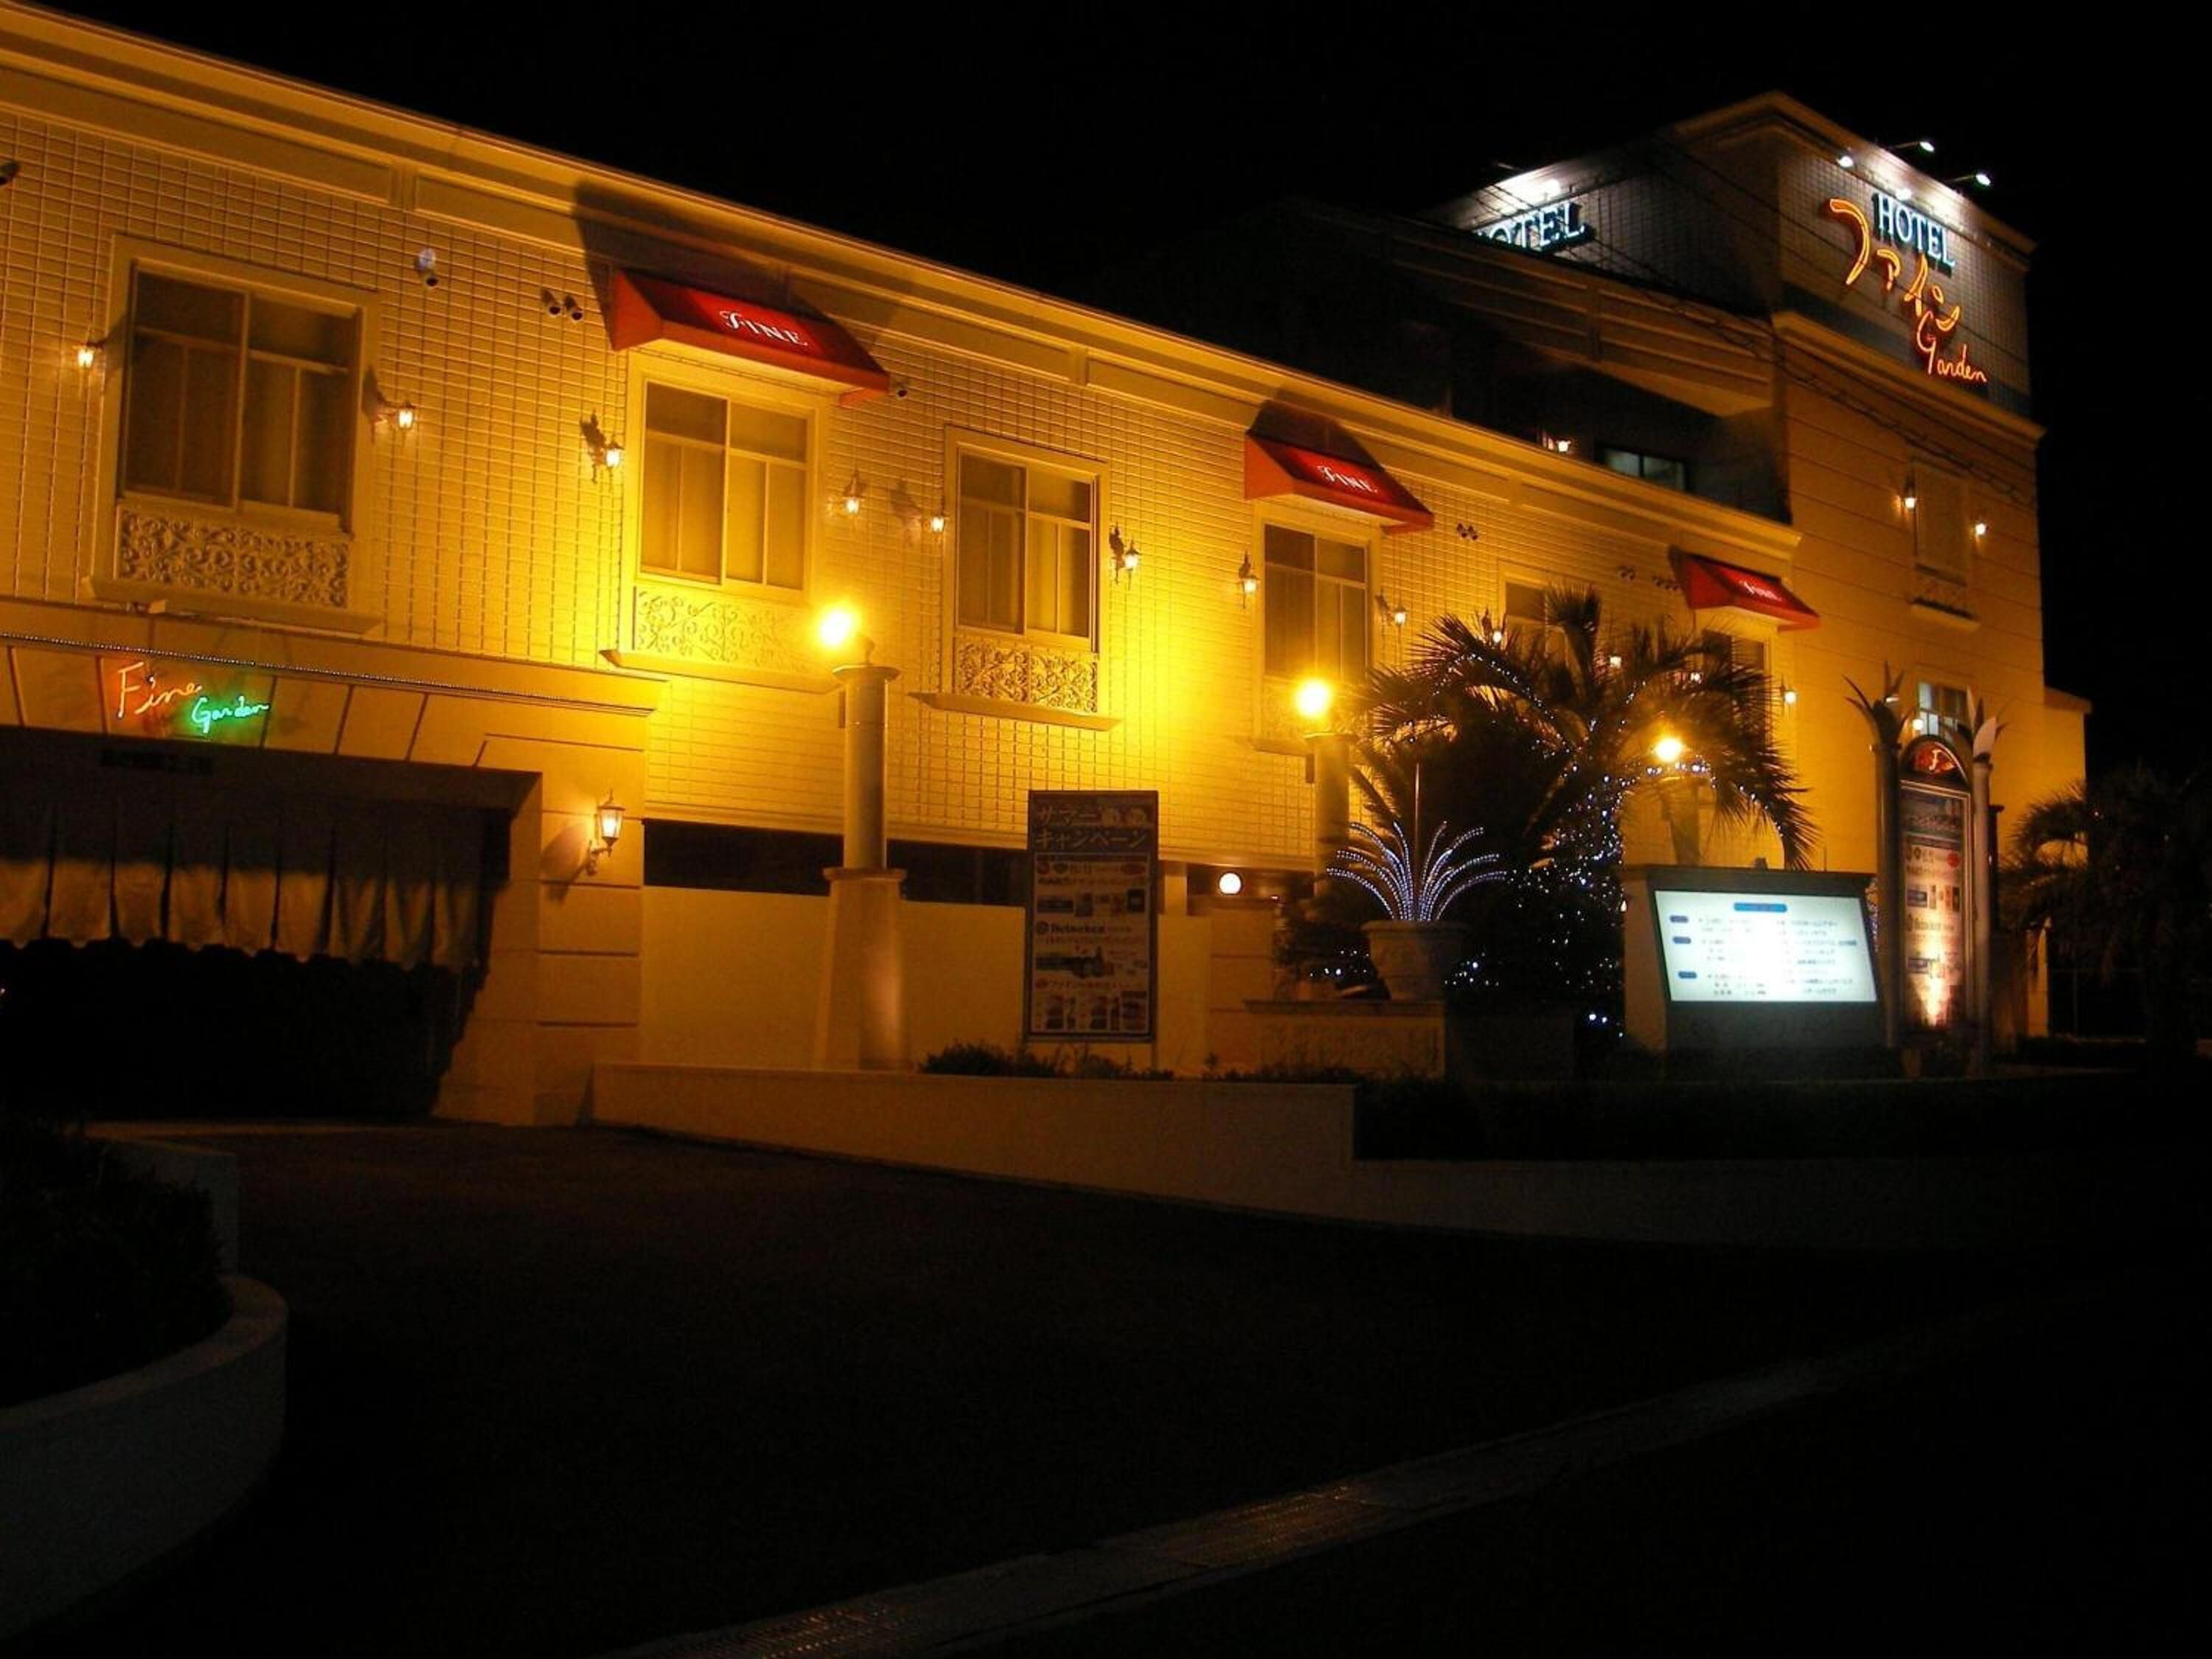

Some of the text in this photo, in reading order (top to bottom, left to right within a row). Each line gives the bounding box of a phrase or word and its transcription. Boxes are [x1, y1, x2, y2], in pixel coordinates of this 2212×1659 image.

[1473, 201, 1585, 248] OTEL
[1877, 192, 1956, 268] HOTEL
[1829, 198, 1961, 332] ファイン
[1916, 310, 1988, 383] Garden
[117, 661, 204, 719] Fine
[190, 695, 270, 734] Garden
[1034, 827, 1147, 849] キャンペーン
